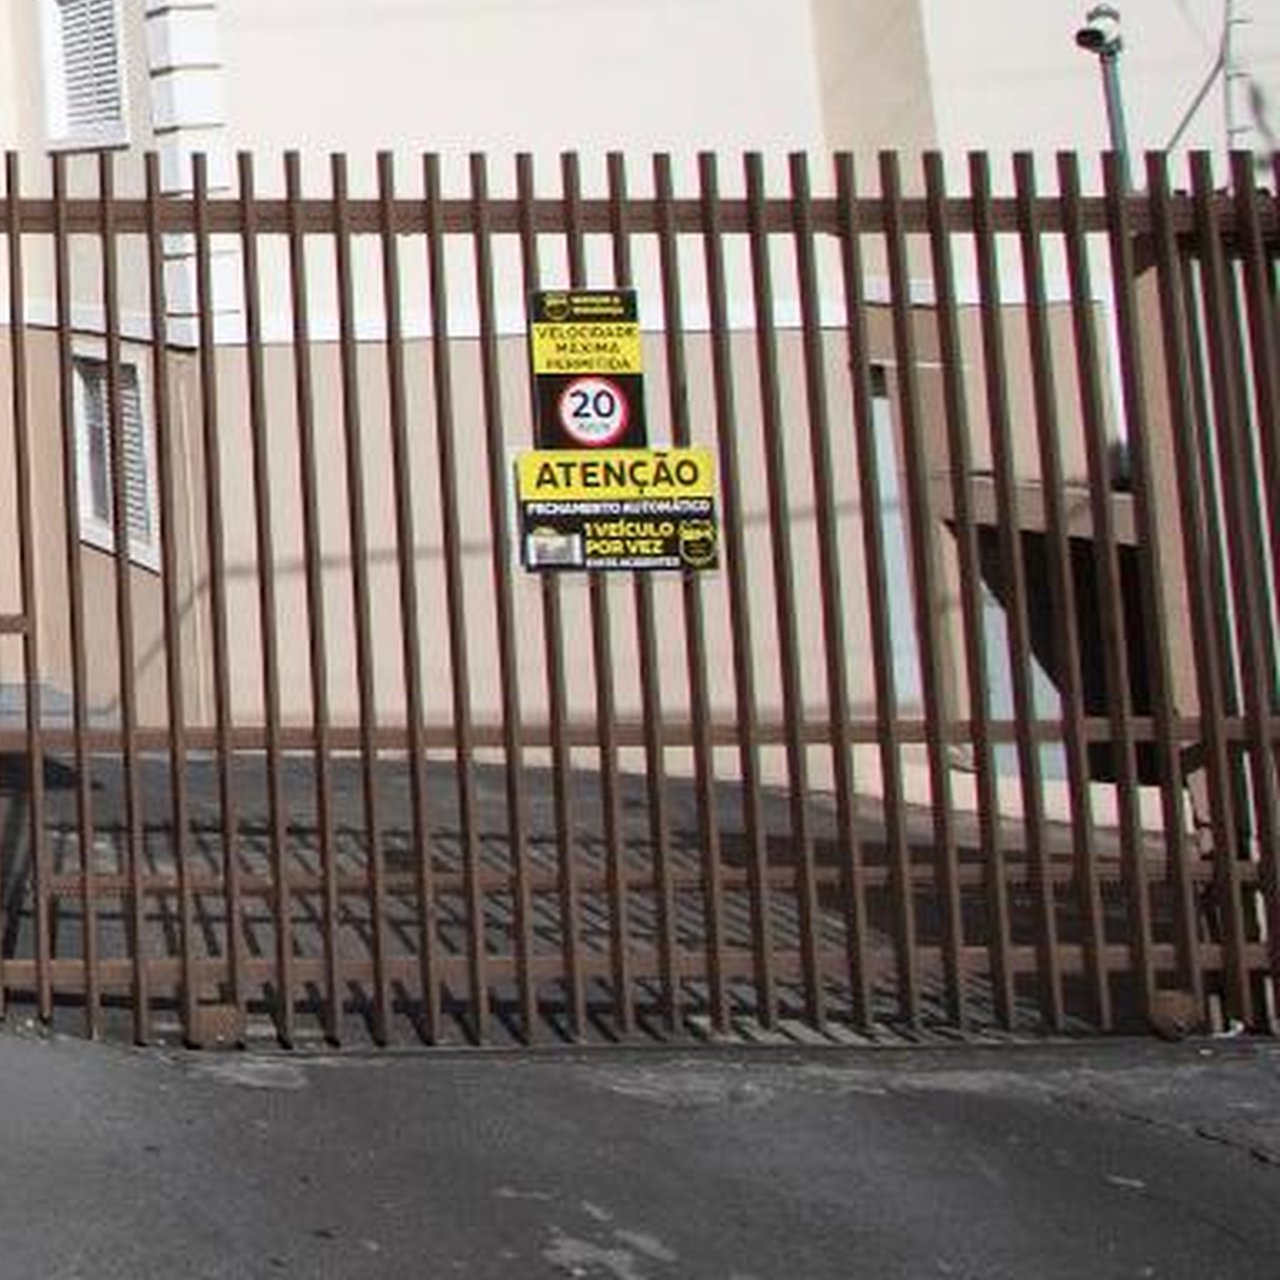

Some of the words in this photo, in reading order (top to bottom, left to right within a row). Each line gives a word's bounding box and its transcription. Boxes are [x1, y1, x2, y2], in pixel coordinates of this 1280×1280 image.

[570, 390, 615, 418] 20
[536, 453, 699, 494] ATENÇÃO
[594, 519, 674, 537] VEÍCULO
[585, 540, 624, 554] POR
[627, 540, 664, 554] VEZ
